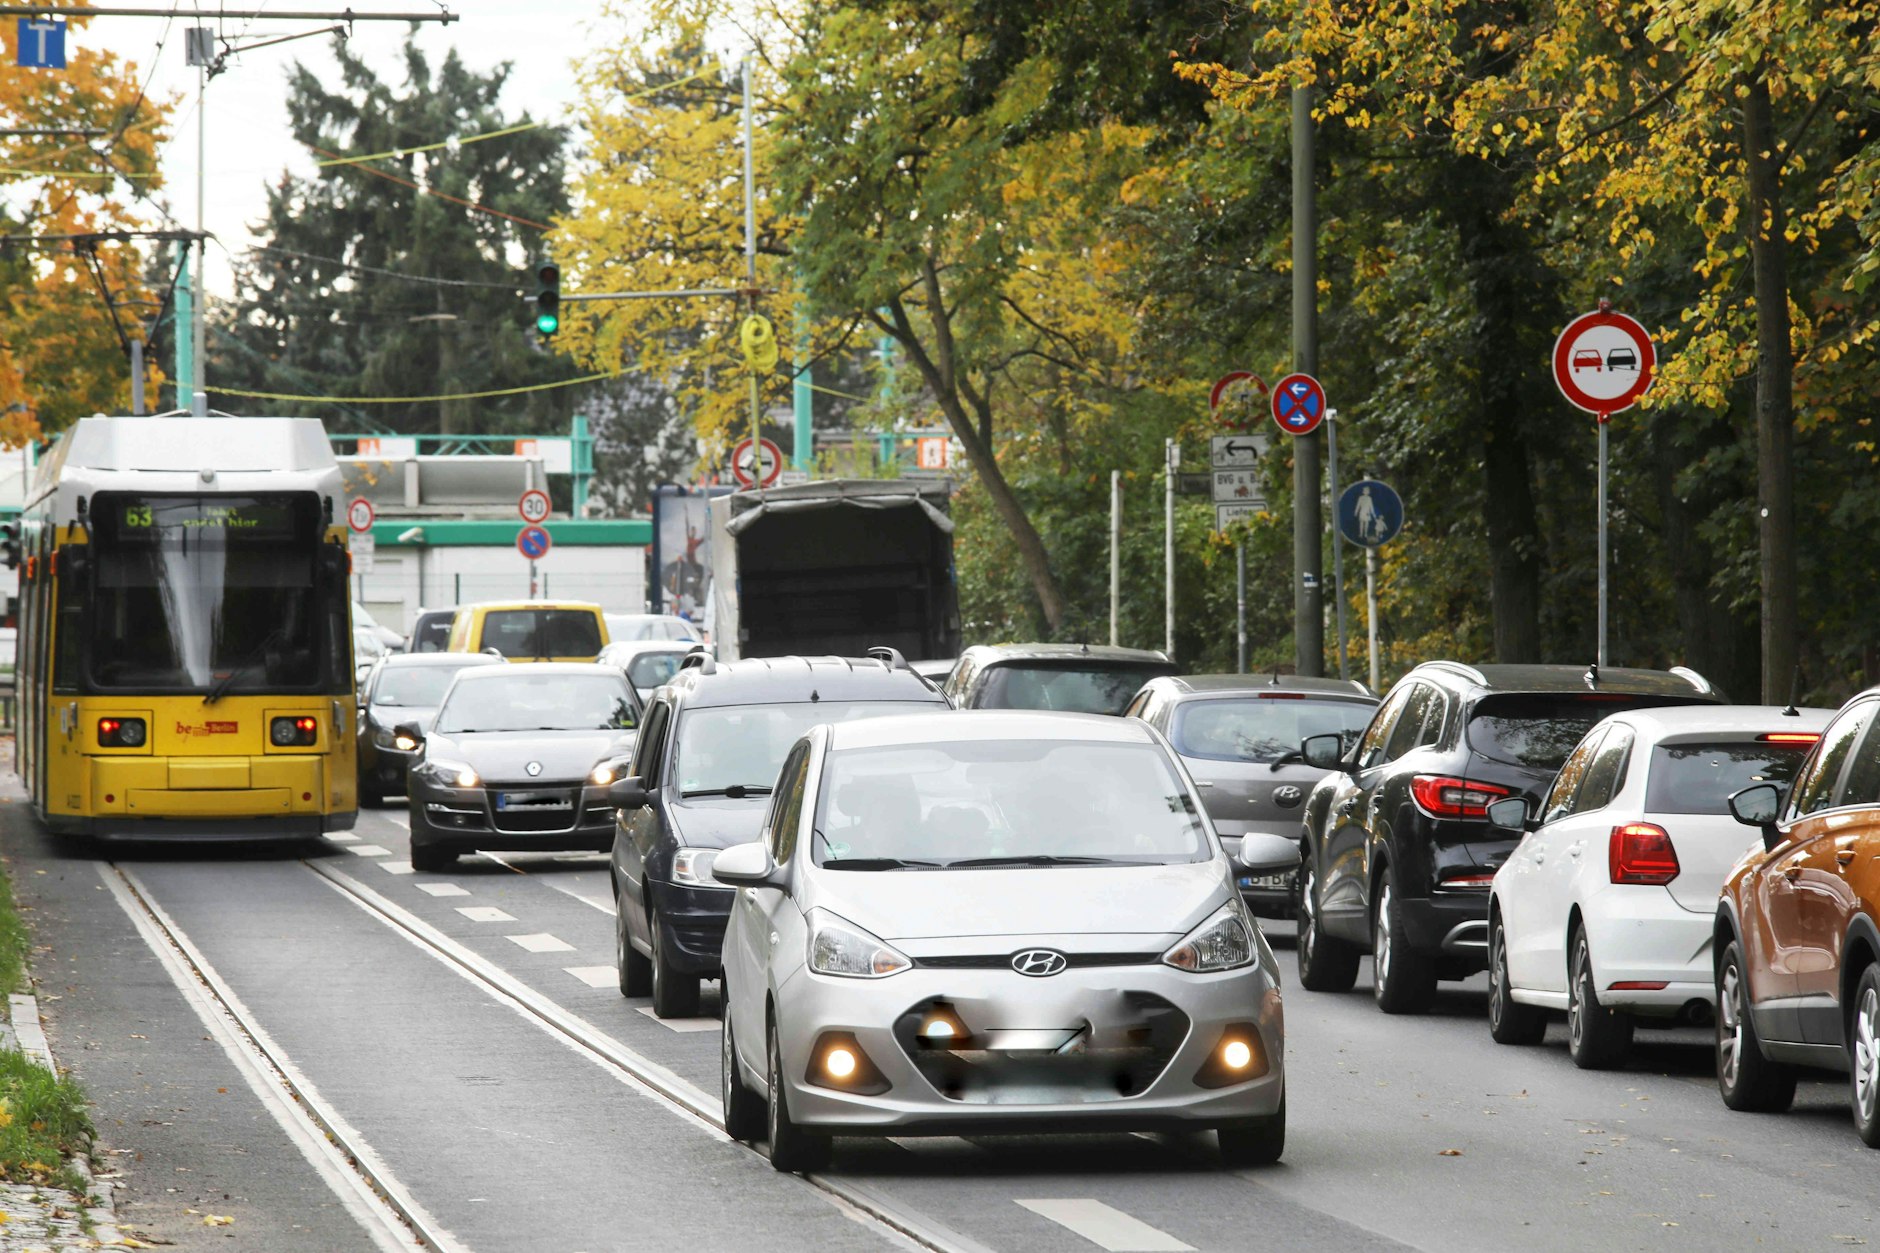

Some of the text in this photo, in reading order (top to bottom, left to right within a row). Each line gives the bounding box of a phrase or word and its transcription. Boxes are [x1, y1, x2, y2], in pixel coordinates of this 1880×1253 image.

[1217, 473, 1234, 485] BVG
[525, 498, 544, 515] 30
[126, 506, 152, 527] 63
[228, 517, 259, 528] hier
